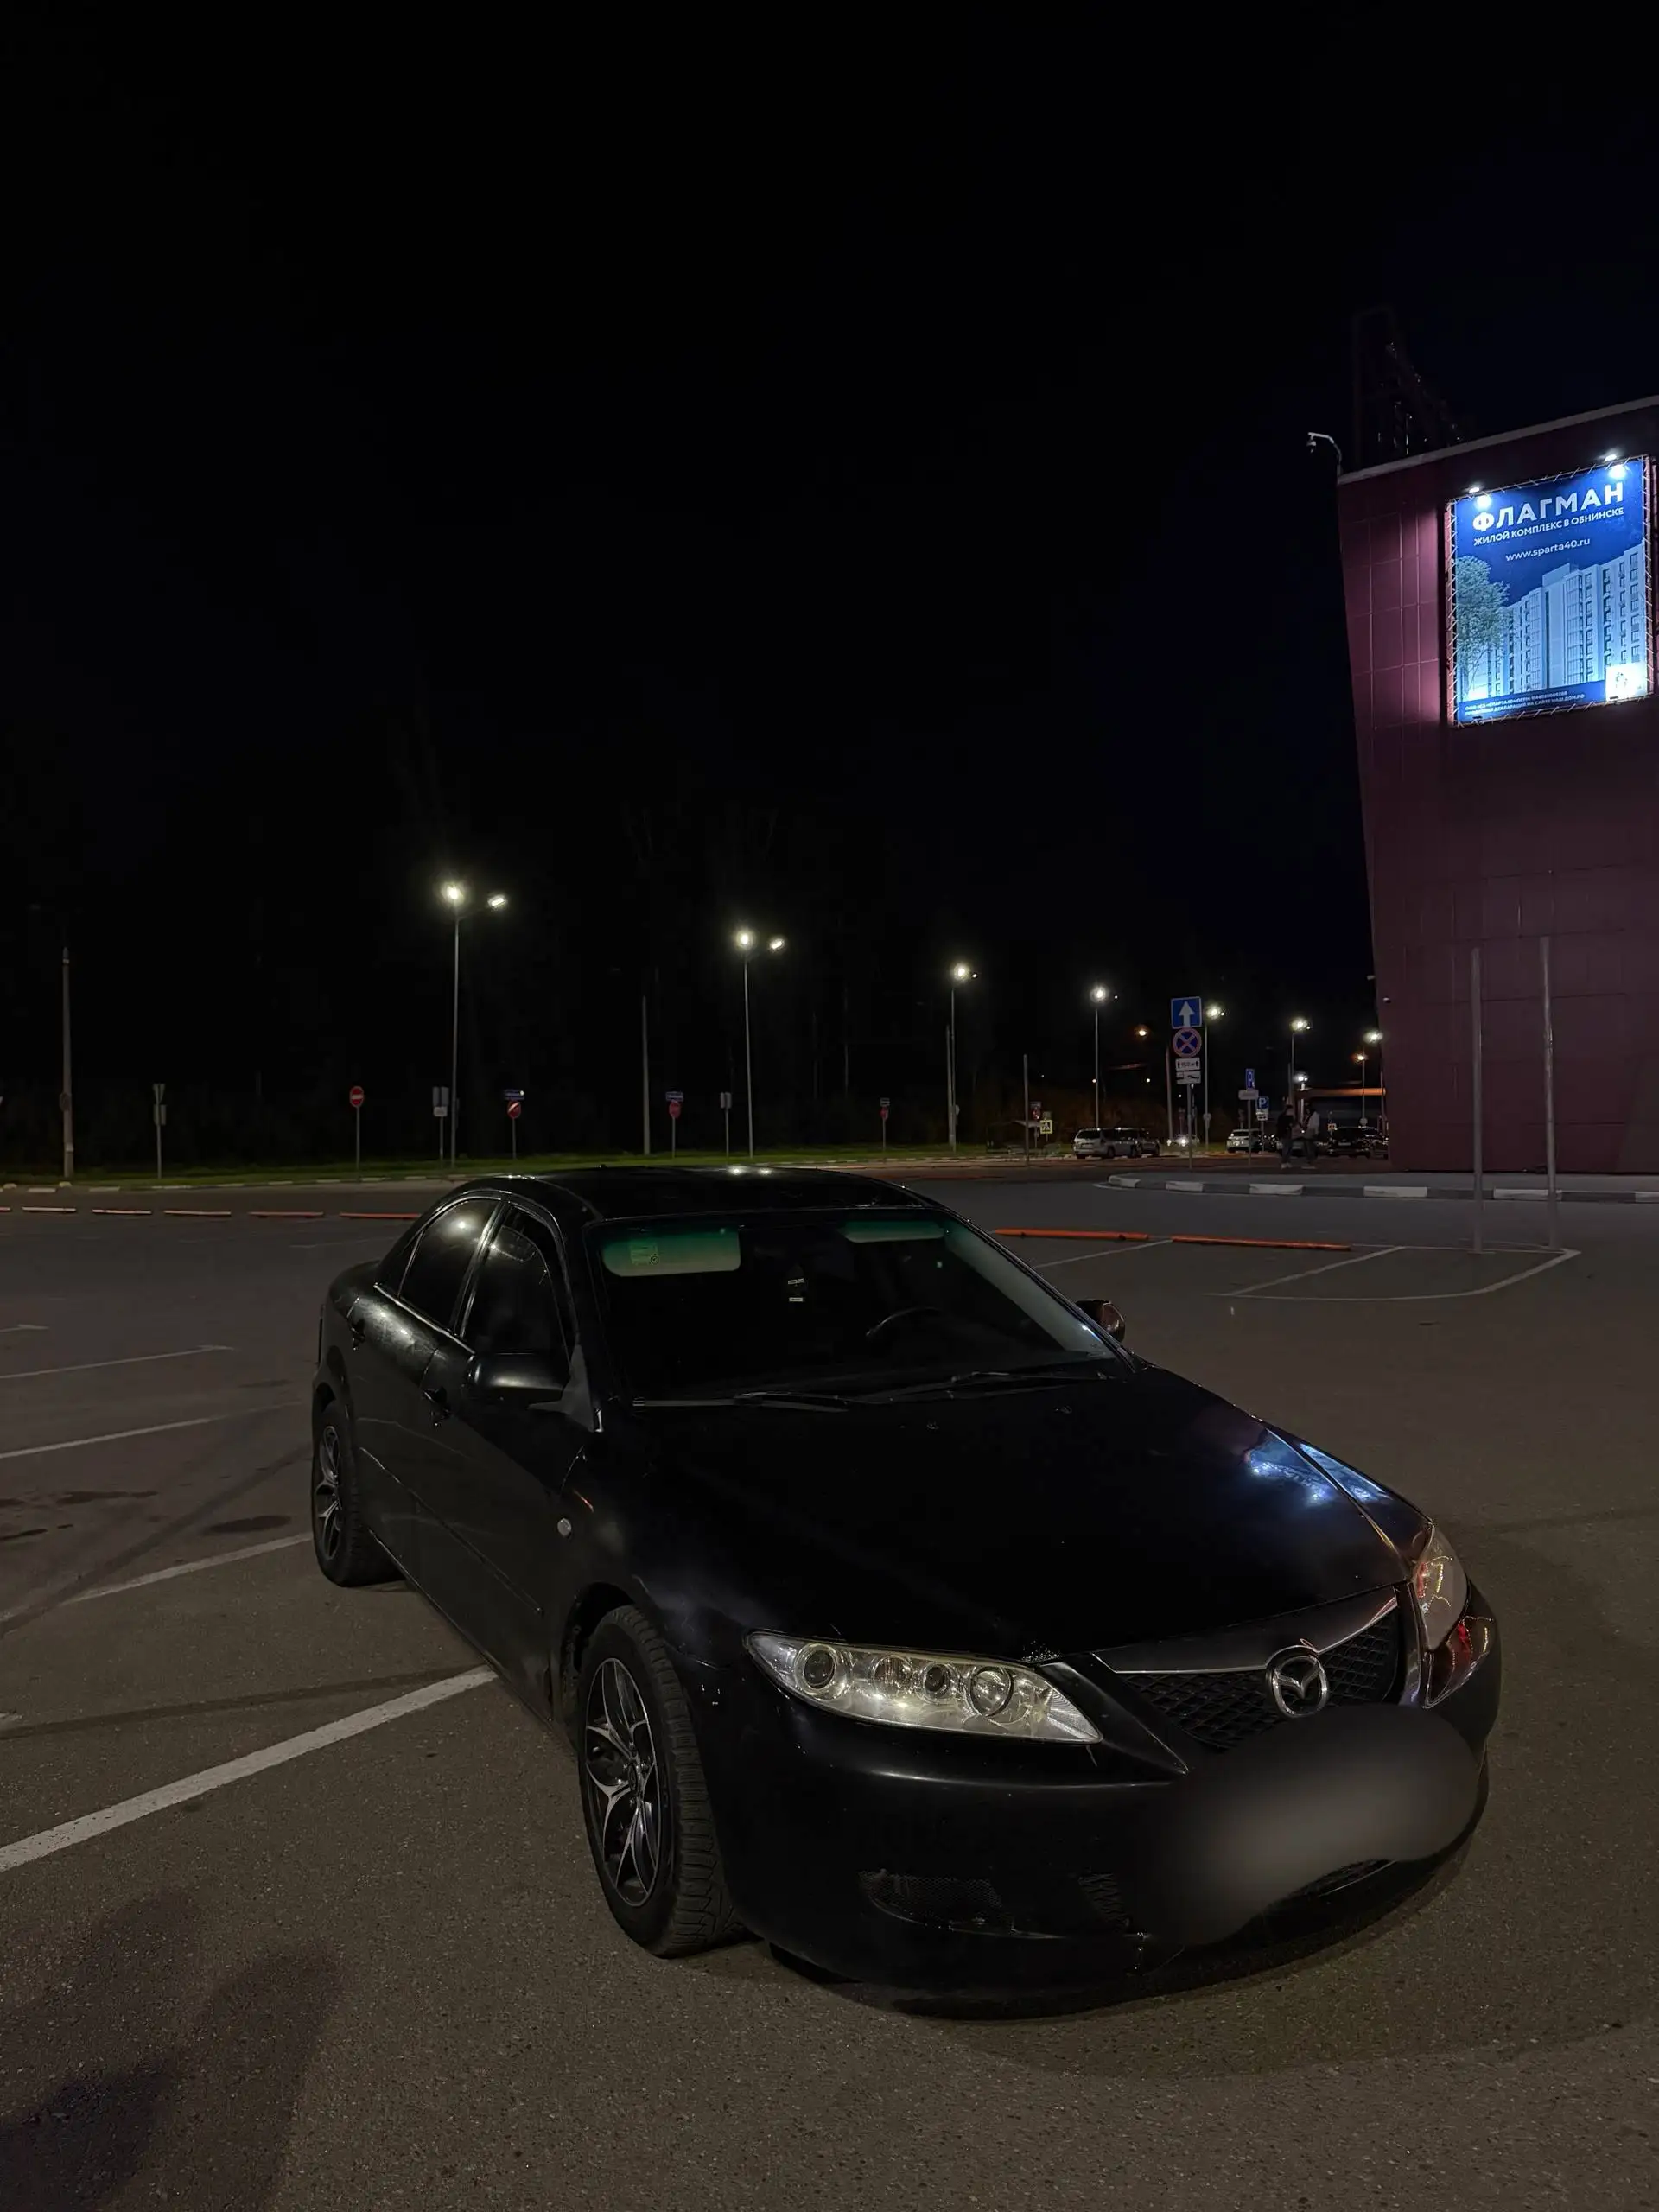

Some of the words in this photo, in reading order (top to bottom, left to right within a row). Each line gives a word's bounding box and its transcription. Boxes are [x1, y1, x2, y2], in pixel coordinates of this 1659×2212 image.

[1472, 481, 1623, 531] ФЛАГМАН
[1473, 531, 1510, 546] ЖИЛОЙ
[1511, 521, 1562, 538] КОМПЛЕКС
[1571, 507, 1624, 524] ОБНИНСКЕ
[1505, 538, 1591, 562] www.sparta40.ru
[1258, 1097, 1266, 1108] P
